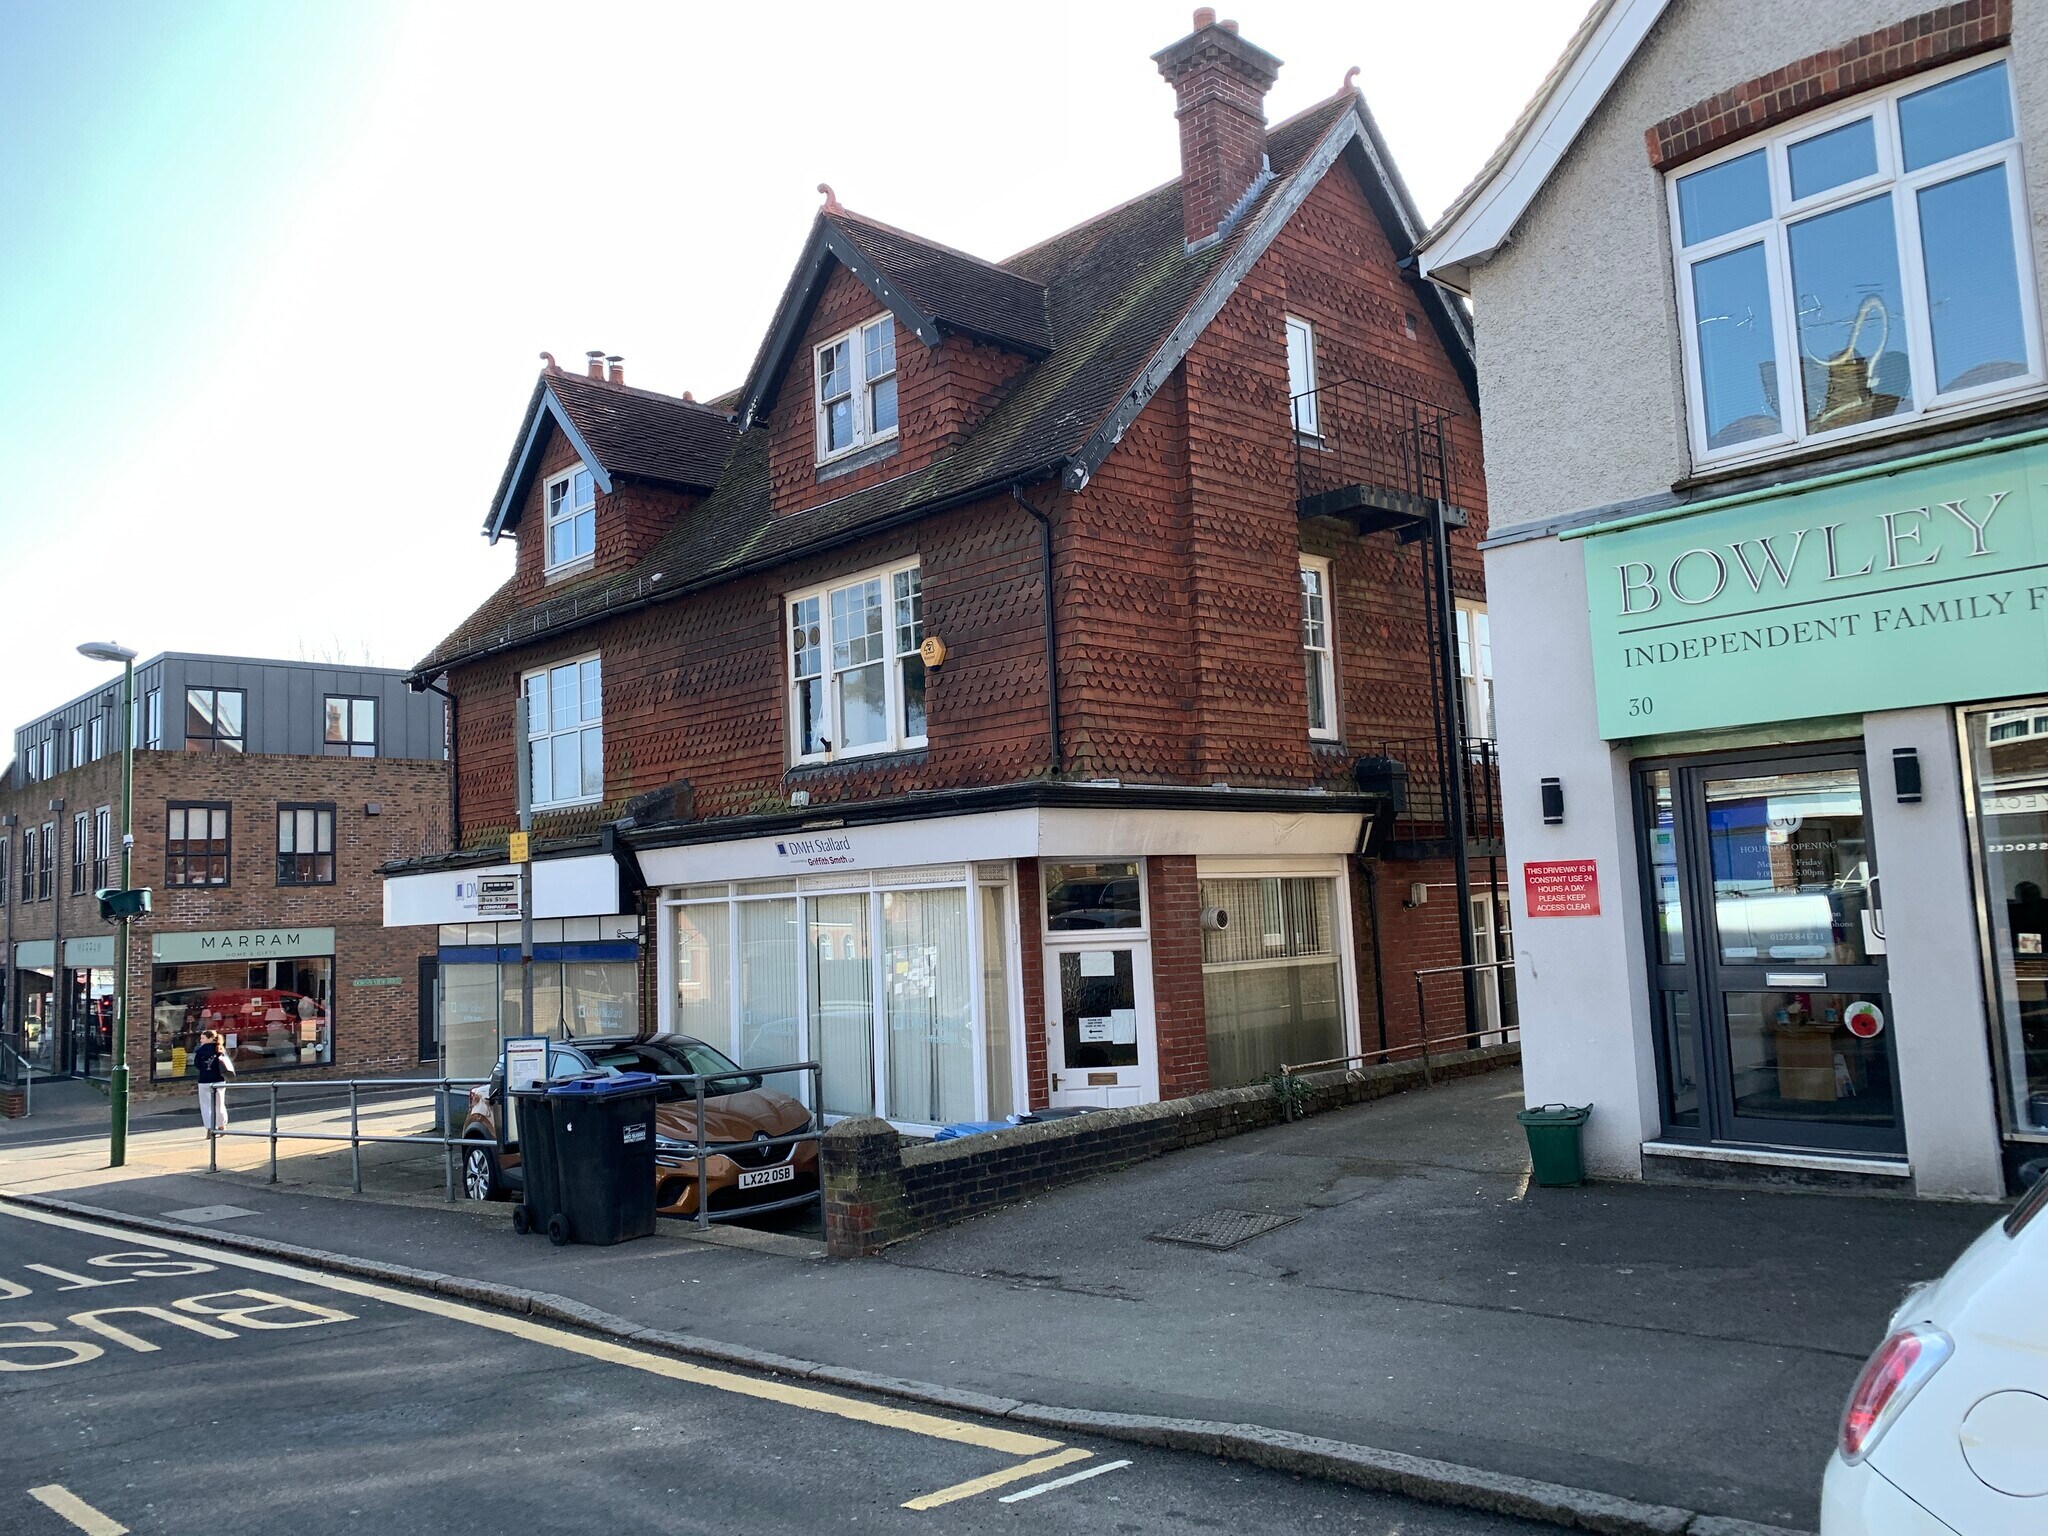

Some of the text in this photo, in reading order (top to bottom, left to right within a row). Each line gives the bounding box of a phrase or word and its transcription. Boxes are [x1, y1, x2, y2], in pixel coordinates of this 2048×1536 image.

[1612, 490, 2014, 616] BOWLEY
[1624, 613, 1861, 669] INDEPENDENT
[1873, 591, 2015, 634] FAMILY
[1628, 696, 1654, 718] 30
[788, 836, 851, 856] DMH Stallard
[1740, 841, 1837, 854] HOURS OF OPENING
[807, 856, 830, 866] Griffith
[830, 854, 848, 865] Smith
[1796, 858, 1823, 868] Friday
[1526, 867, 1542, 875] THIS
[1543, 865, 1578, 874] DRIVEWAY
[1579, 865, 1586, 873] IS
[1795, 868, 1825, 878] 5.00pm
[1529, 876, 1567, 884] CONSTANT
[1537, 885, 1564, 893] HOURS
[1570, 884, 1586, 892] DAY.
[1538, 893, 1586, 902] PLEASE KEEP
[1536, 903, 1591, 912] ACCESS CLEAR
[201, 932, 301, 949] MARRAM
[743, 1167, 791, 1187] LX22 OSB
[0, 1288, 360, 1372] BUS
